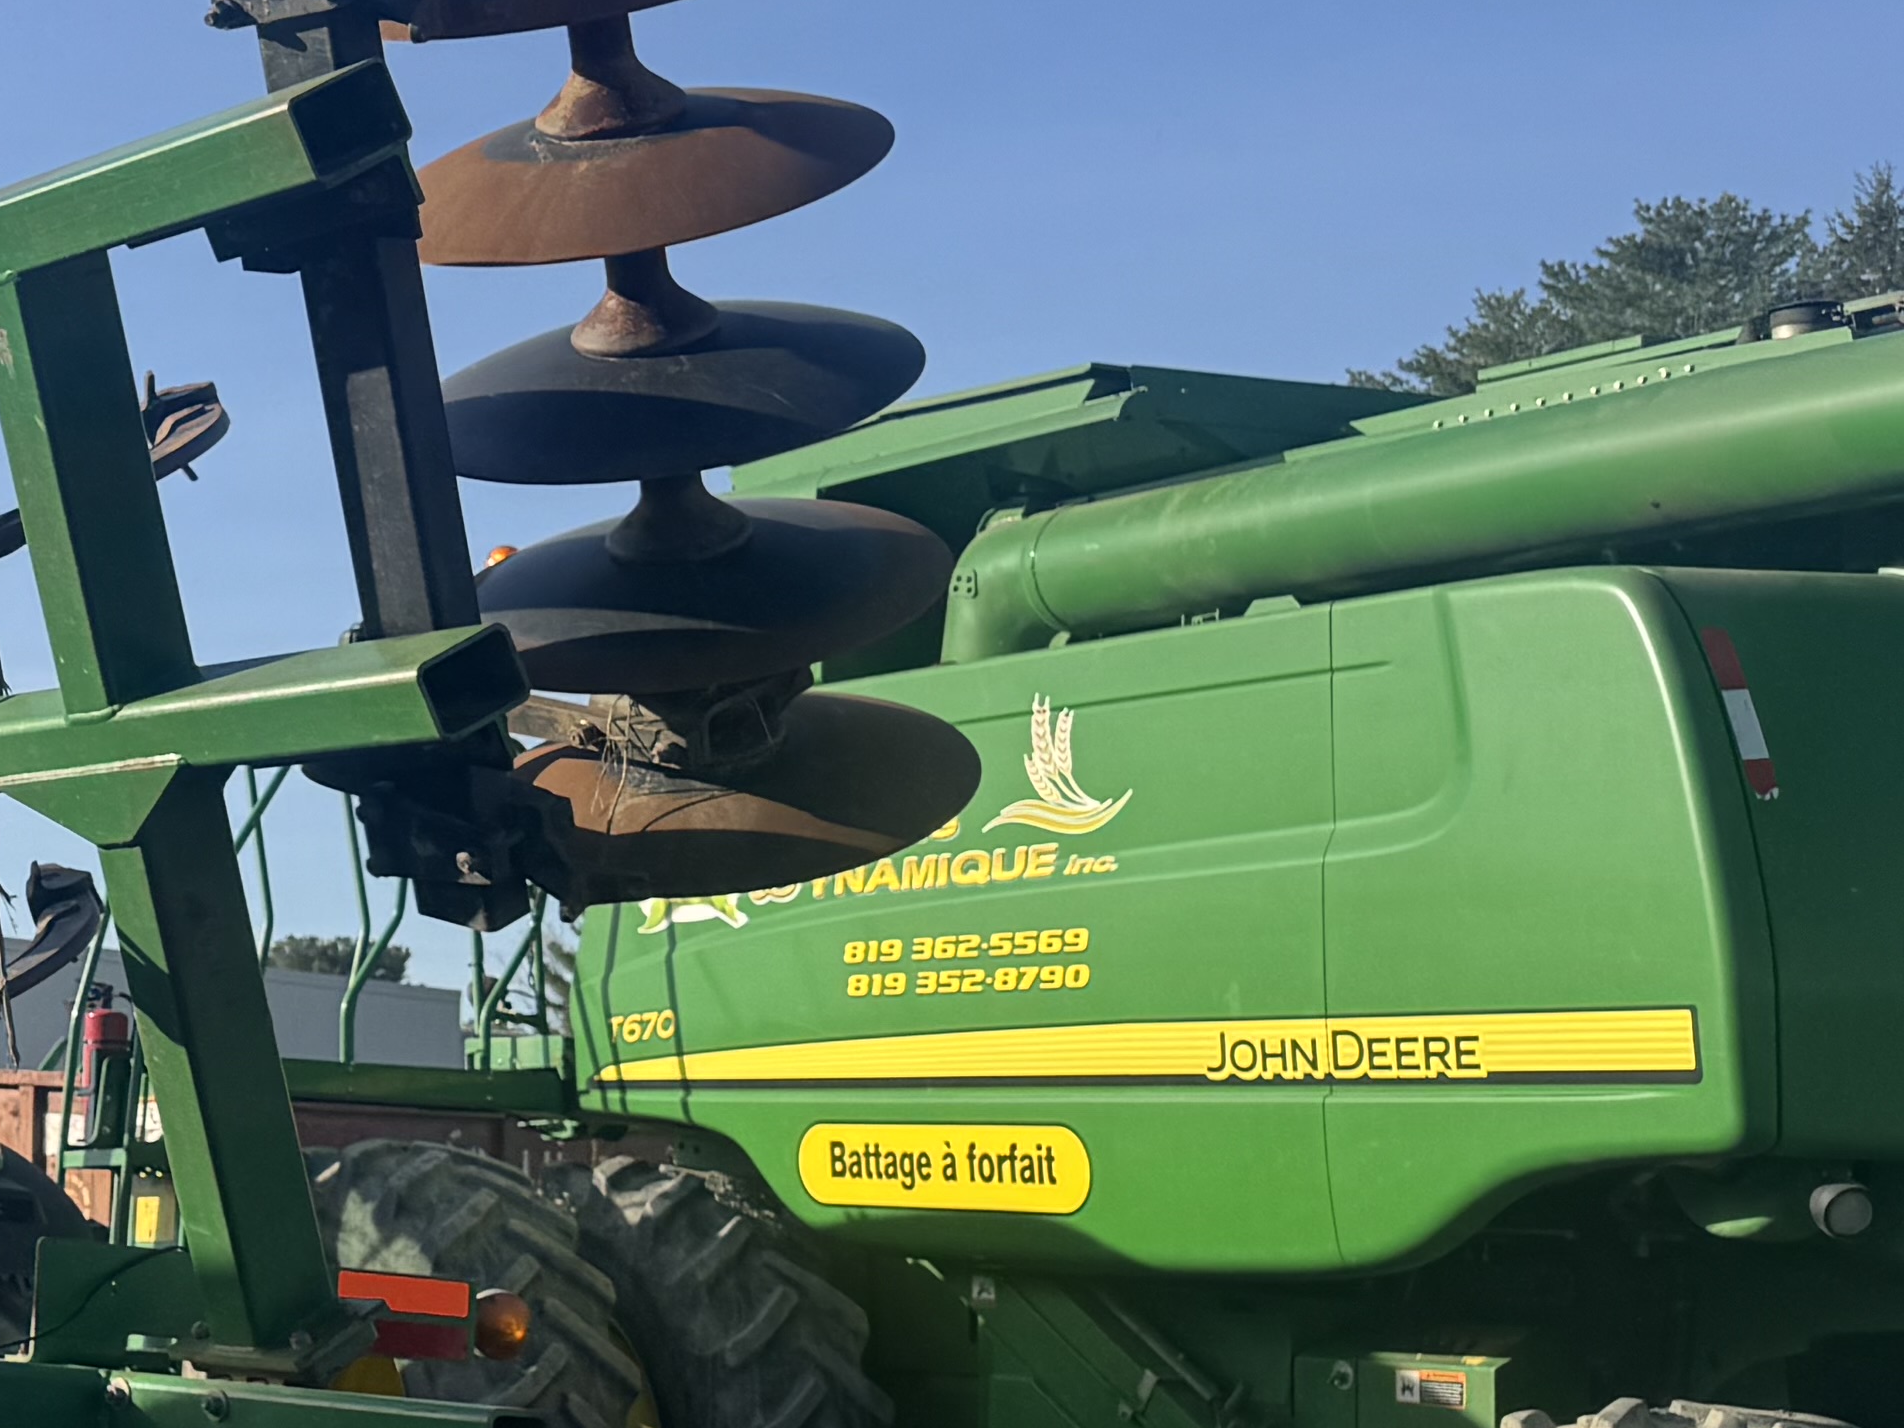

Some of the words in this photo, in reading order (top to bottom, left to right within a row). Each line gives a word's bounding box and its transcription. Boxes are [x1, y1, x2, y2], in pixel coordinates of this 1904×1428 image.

[843, 939, 903, 964] 819
[847, 973, 907, 997] 819
[608, 1008, 676, 1043] T670
[1206, 1031, 1319, 1073] JOHN
[1331, 1029, 1482, 1071] DEERE
[829, 1140, 932, 1191] Battage
[942, 1140, 958, 1182] à
[967, 1141, 1058, 1185] forfait
